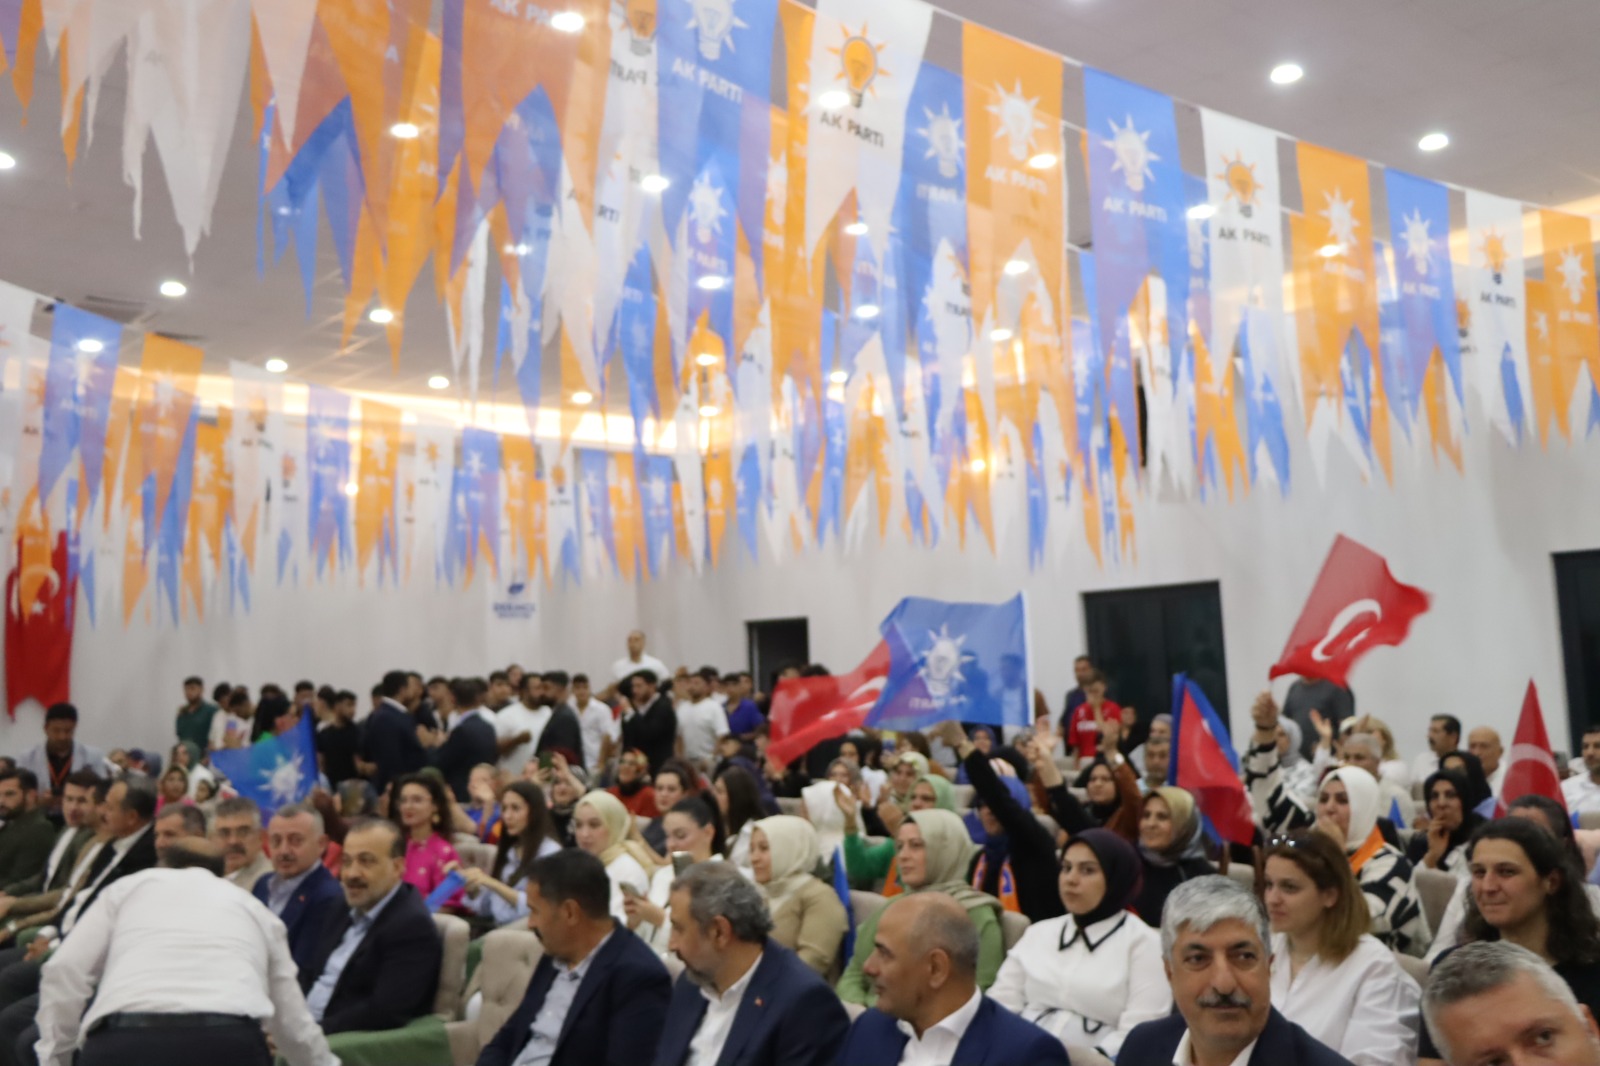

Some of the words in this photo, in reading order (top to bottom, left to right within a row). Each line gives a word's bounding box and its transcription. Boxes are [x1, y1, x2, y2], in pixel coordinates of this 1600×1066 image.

[672, 57, 696, 81] AK
[819, 112, 843, 130] AK
[985, 165, 1008, 185] AK
[1103, 196, 1125, 214] AK
[1218, 226, 1238, 242] AK
